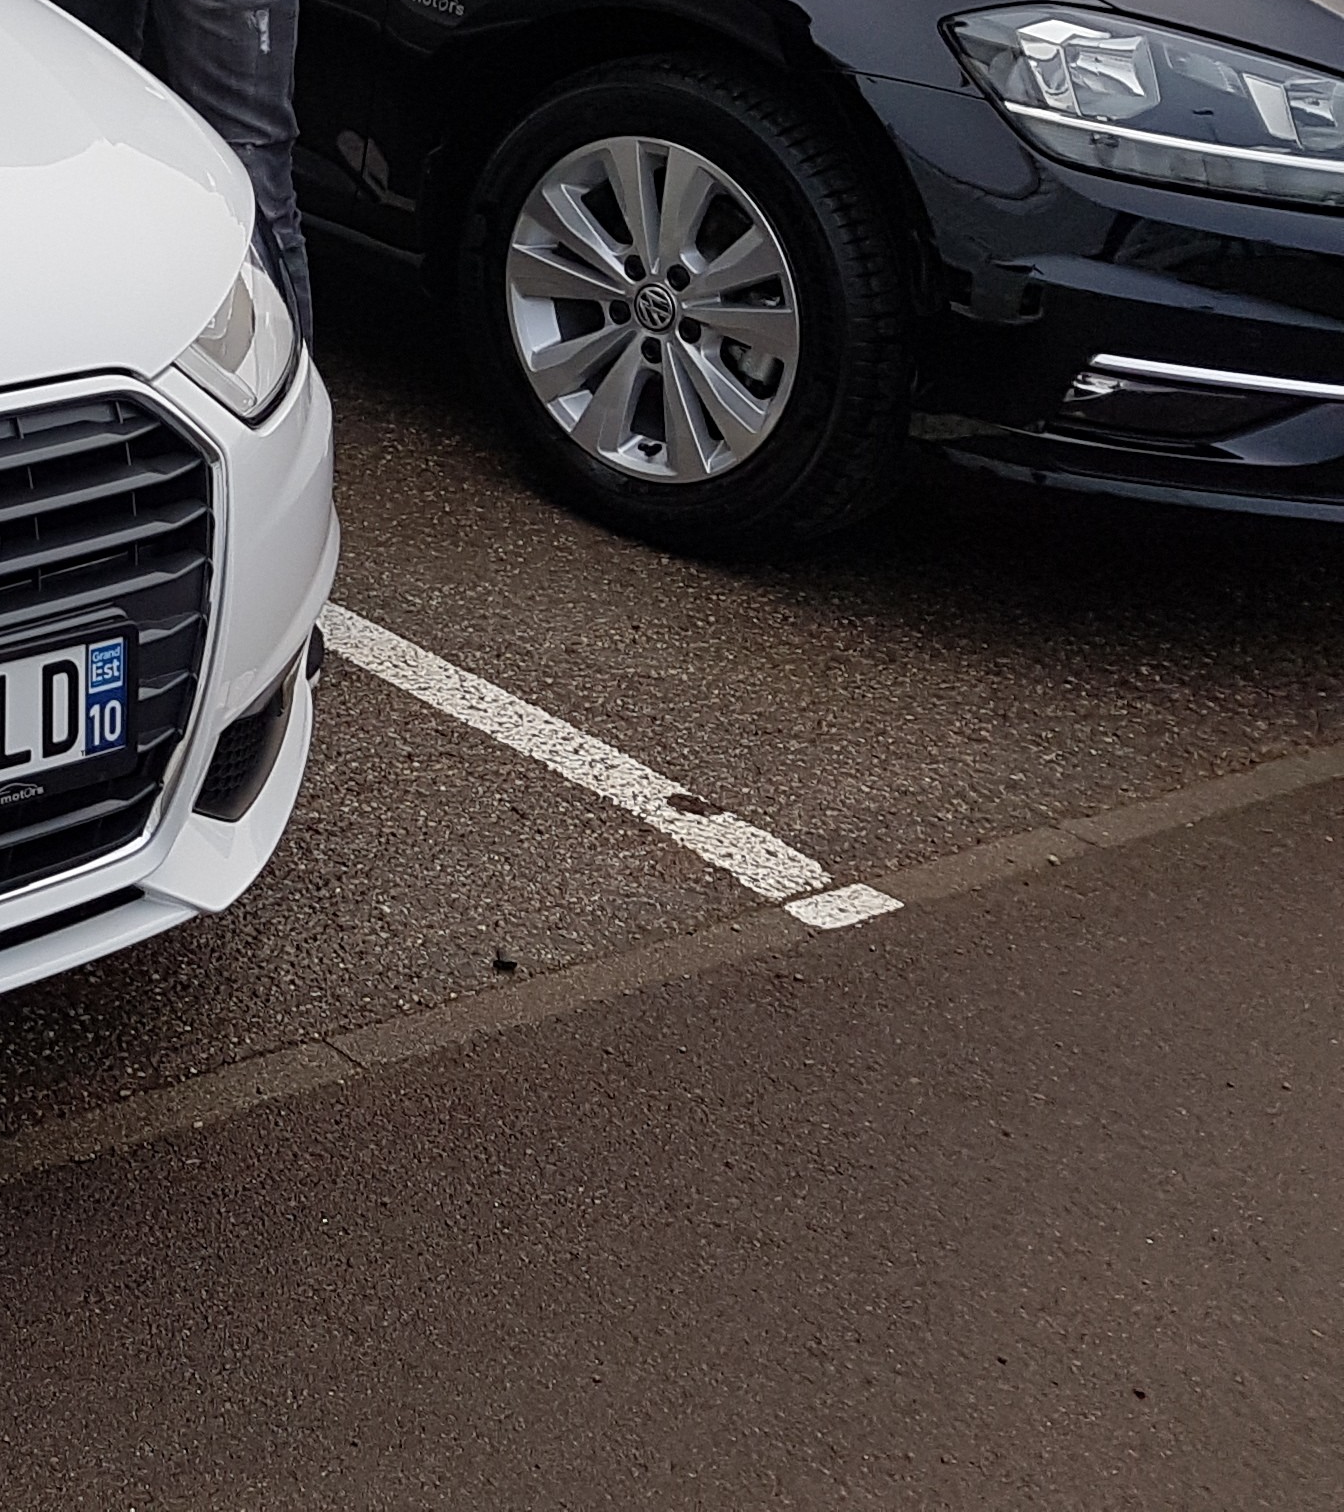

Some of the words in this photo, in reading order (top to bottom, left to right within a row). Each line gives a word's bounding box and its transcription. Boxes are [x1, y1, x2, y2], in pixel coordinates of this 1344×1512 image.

[92, 645, 121, 662] Grand
[92, 658, 120, 682] Est
[89, 699, 123, 747] 10
